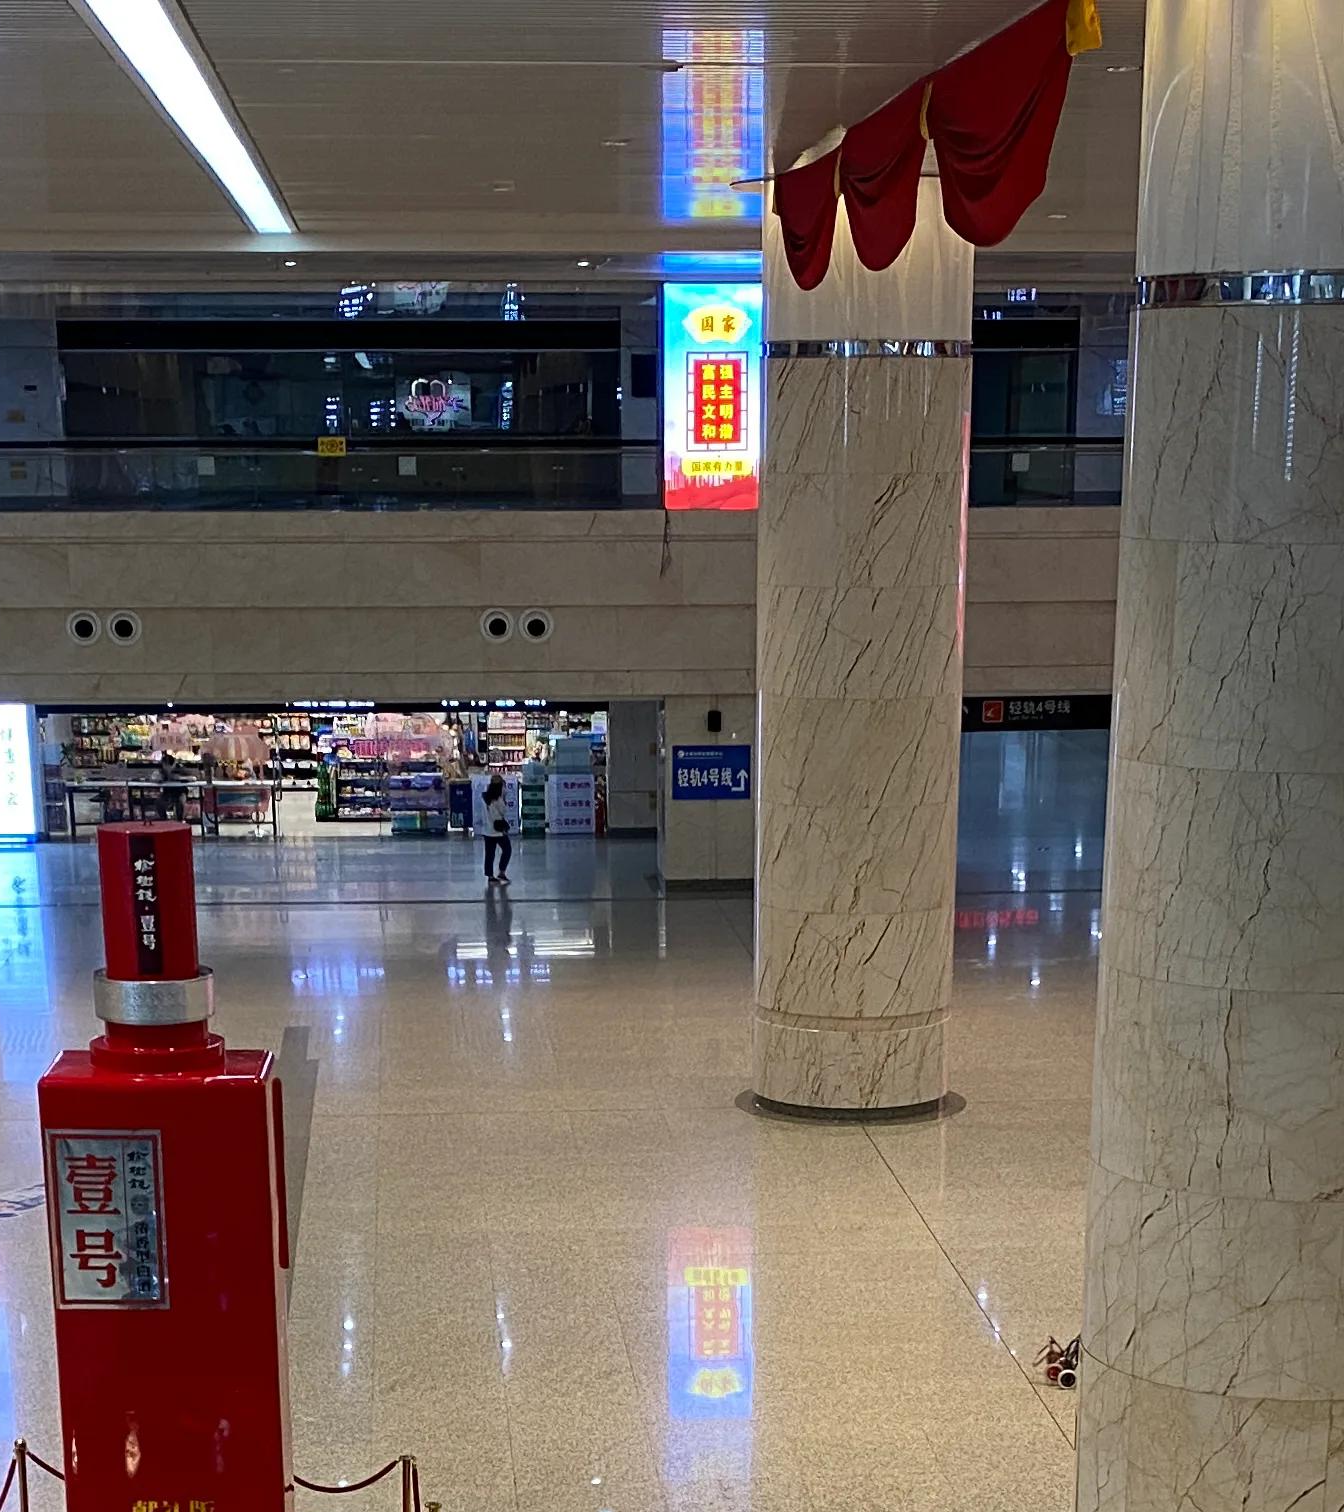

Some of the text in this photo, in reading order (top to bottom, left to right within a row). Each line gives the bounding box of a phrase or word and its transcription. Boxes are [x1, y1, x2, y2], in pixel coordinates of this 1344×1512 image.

[701, 315, 736, 332] 国家
[702, 384, 735, 400] 民主
[702, 404, 735, 420] 文明
[702, 423, 735, 440] 和谐
[1008, 700, 1071, 715] 轻轨4号线
[678, 768, 733, 787] 轻轨4号线
[64, 1153, 123, 1288] 壹号
